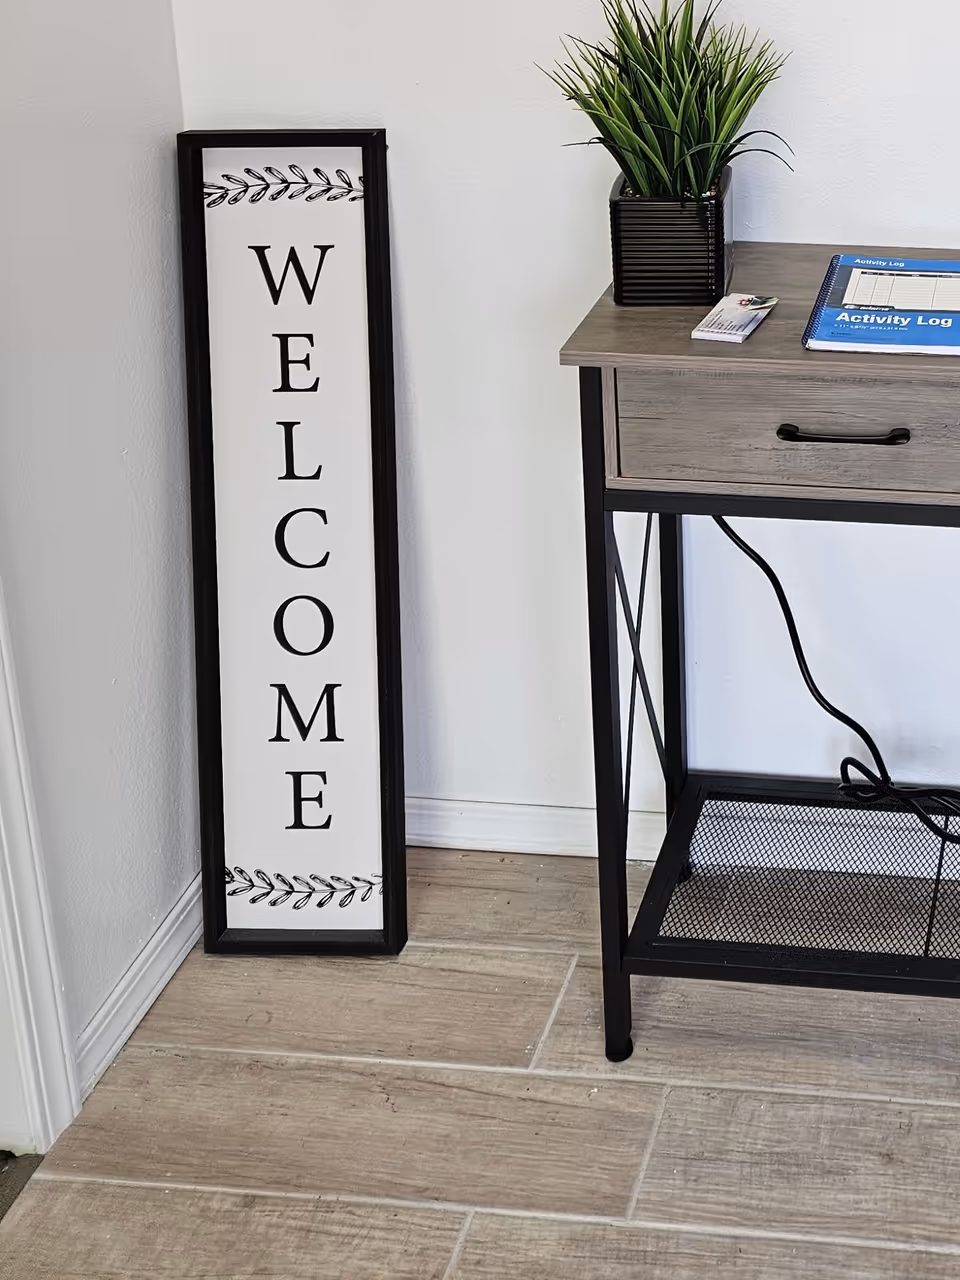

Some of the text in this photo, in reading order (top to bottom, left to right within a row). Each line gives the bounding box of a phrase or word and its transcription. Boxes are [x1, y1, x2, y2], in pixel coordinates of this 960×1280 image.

[854, 258, 887, 266] Activity
[836, 312, 912, 326] Activity
[917, 315, 953, 328] Log
[248, 244, 345, 832] WELCOME
